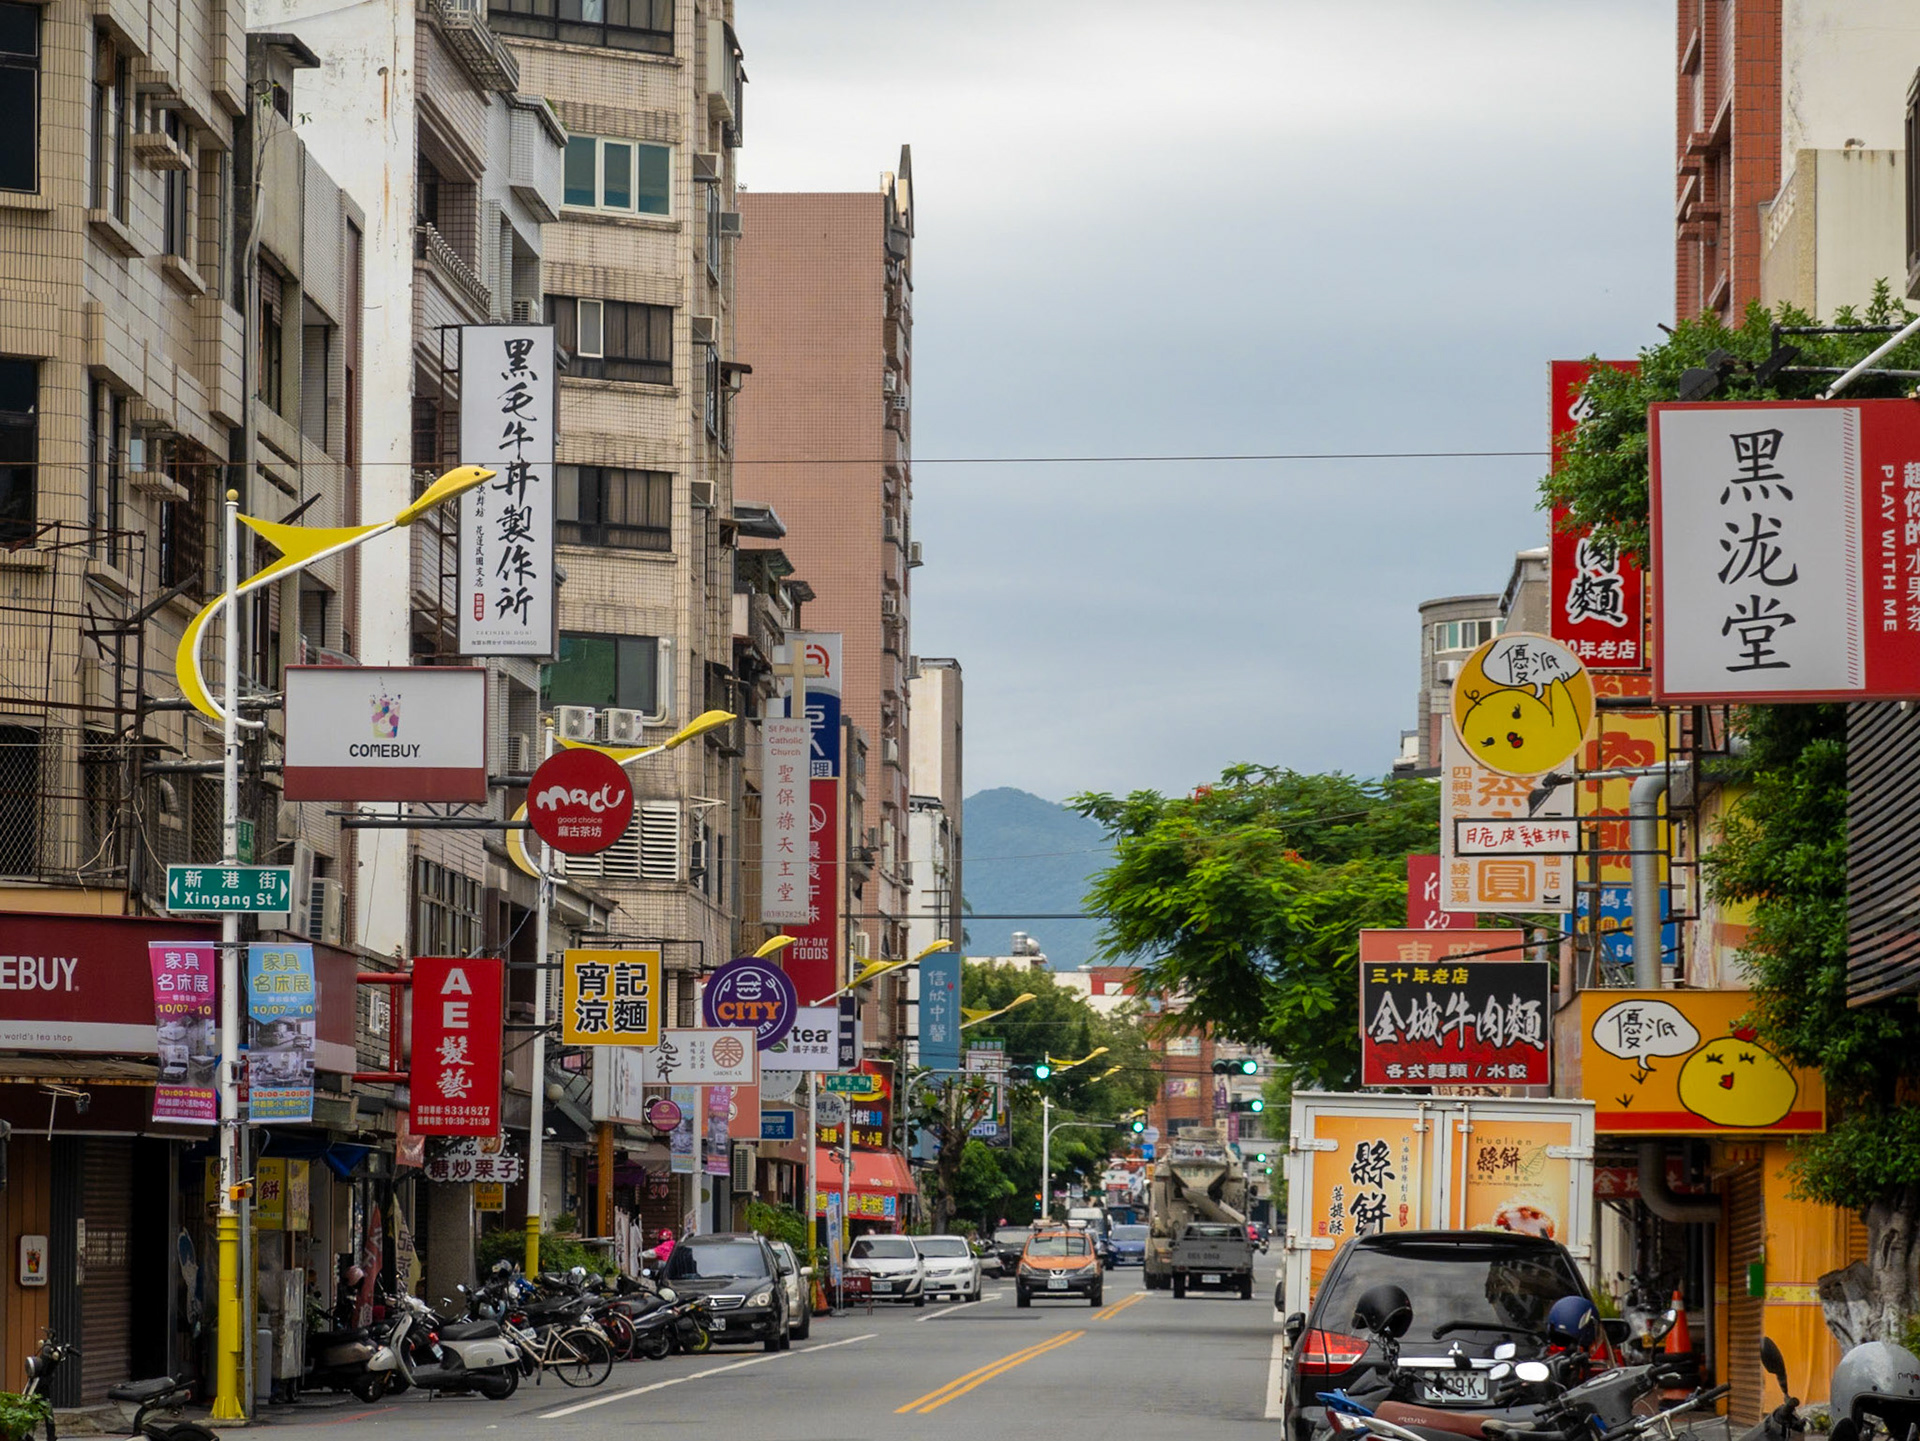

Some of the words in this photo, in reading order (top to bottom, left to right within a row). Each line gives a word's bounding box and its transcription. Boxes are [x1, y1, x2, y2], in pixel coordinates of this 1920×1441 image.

[493, 339, 540, 625] 黑毛牛丼製作所
[1881, 465, 1895, 522] PLAY
[1882, 529, 1896, 590] WITH
[1883, 599, 1897, 632] ME
[350, 744, 419, 757] COMEBUY
[771, 748, 801, 756] Church
[578, 816, 602, 824] choice
[558, 826, 602, 837] 麻古茶坊
[776, 764, 795, 902] 聖保祿天主堂
[184, 870, 277, 889] 新港街
[184, 891, 250, 908] Xingang
[256, 891, 276, 905] St.
[793, 938, 828, 946] DAY-DAY
[165, 952, 199, 970] 家具
[263, 953, 299, 971] 家具
[793, 948, 828, 959] FOODS
[157, 974, 209, 992] 名床展
[254, 974, 311, 993] 名床展
[575, 962, 648, 997] 宵記
[1371, 968, 1469, 984] 三十年老店
[717, 1001, 782, 1020] CITY
[929, 970, 947, 1043] 信欣中醫
[575, 999, 648, 1033] 涼麵
[1367, 990, 1545, 1050] 金城牛肉麵
[791, 1026, 828, 1042] tea
[1608, 1008, 1678, 1049] 優派
[4, 1032, 33, 1042] world's
[36, 1033, 50, 1042] tea
[53, 1033, 73, 1044] shop
[1476, 1137, 1532, 1145] Hualien
[430, 1159, 516, 1178] 糖炒栗子
